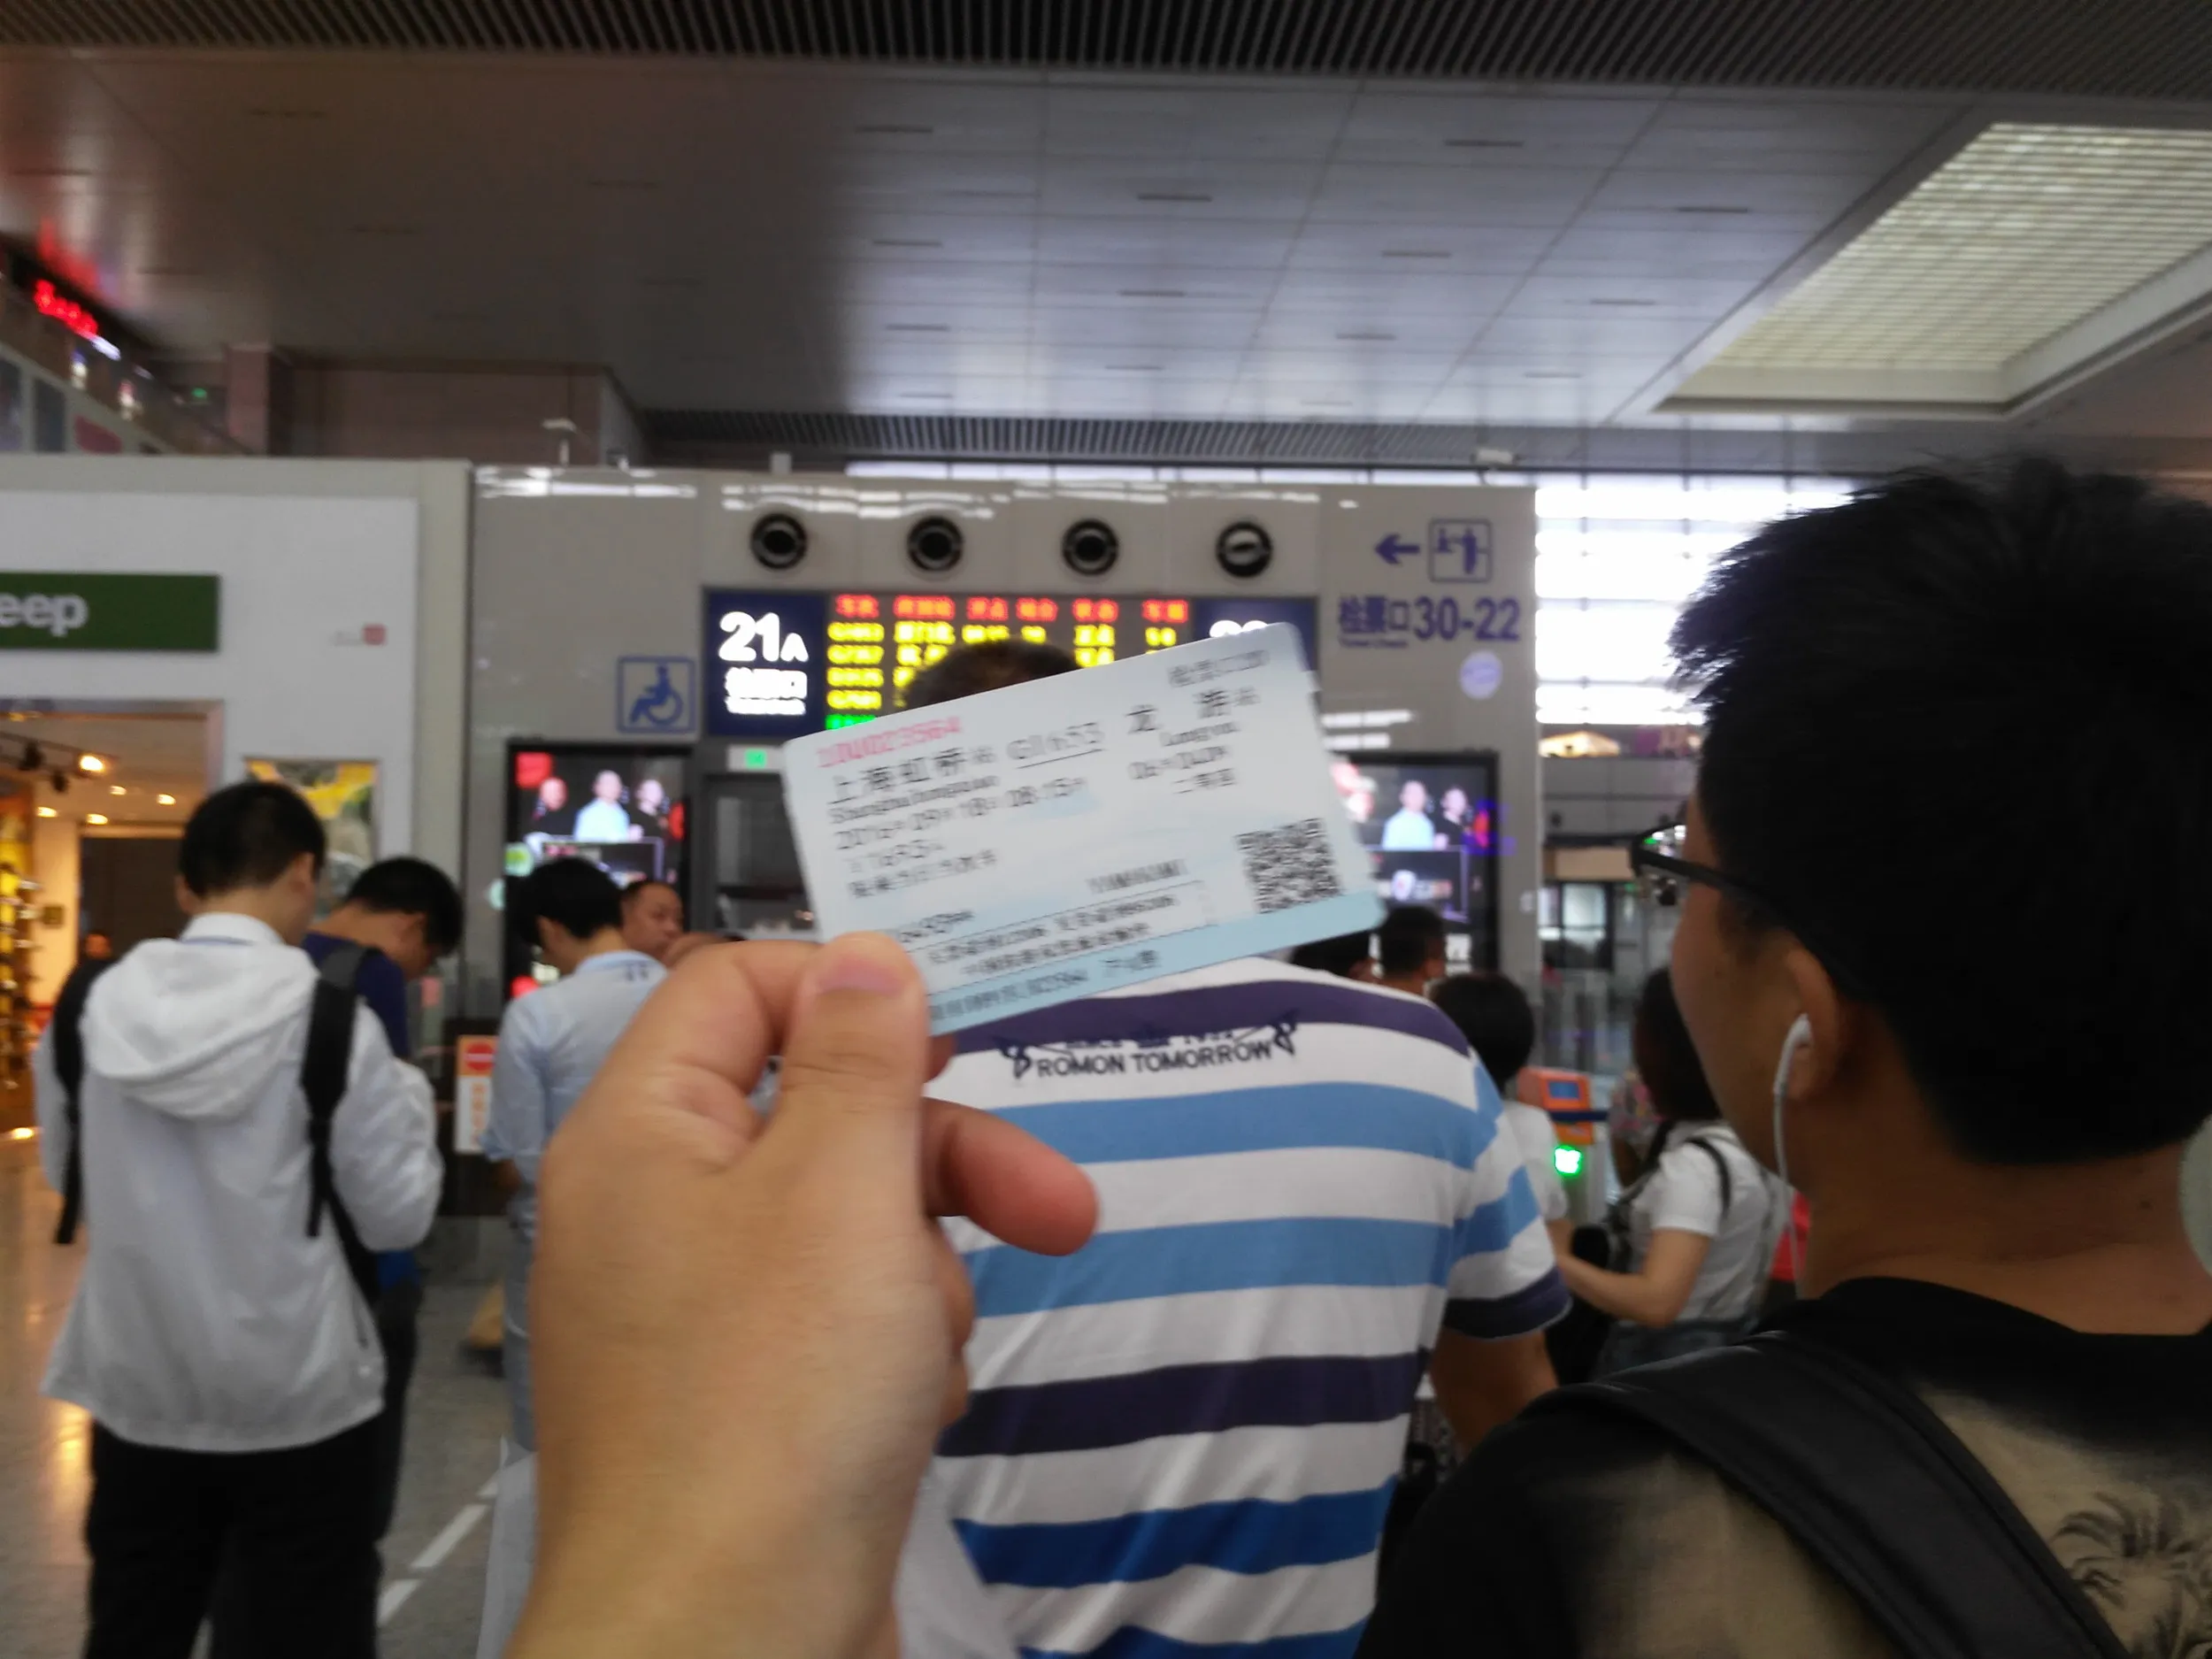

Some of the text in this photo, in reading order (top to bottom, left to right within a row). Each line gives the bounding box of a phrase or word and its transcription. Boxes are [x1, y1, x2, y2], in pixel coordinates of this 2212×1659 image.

[718, 611, 809, 662] 21A
[1037, 1051, 1126, 1078] ROMON
[1133, 1040, 1275, 1073] TOMORROW
